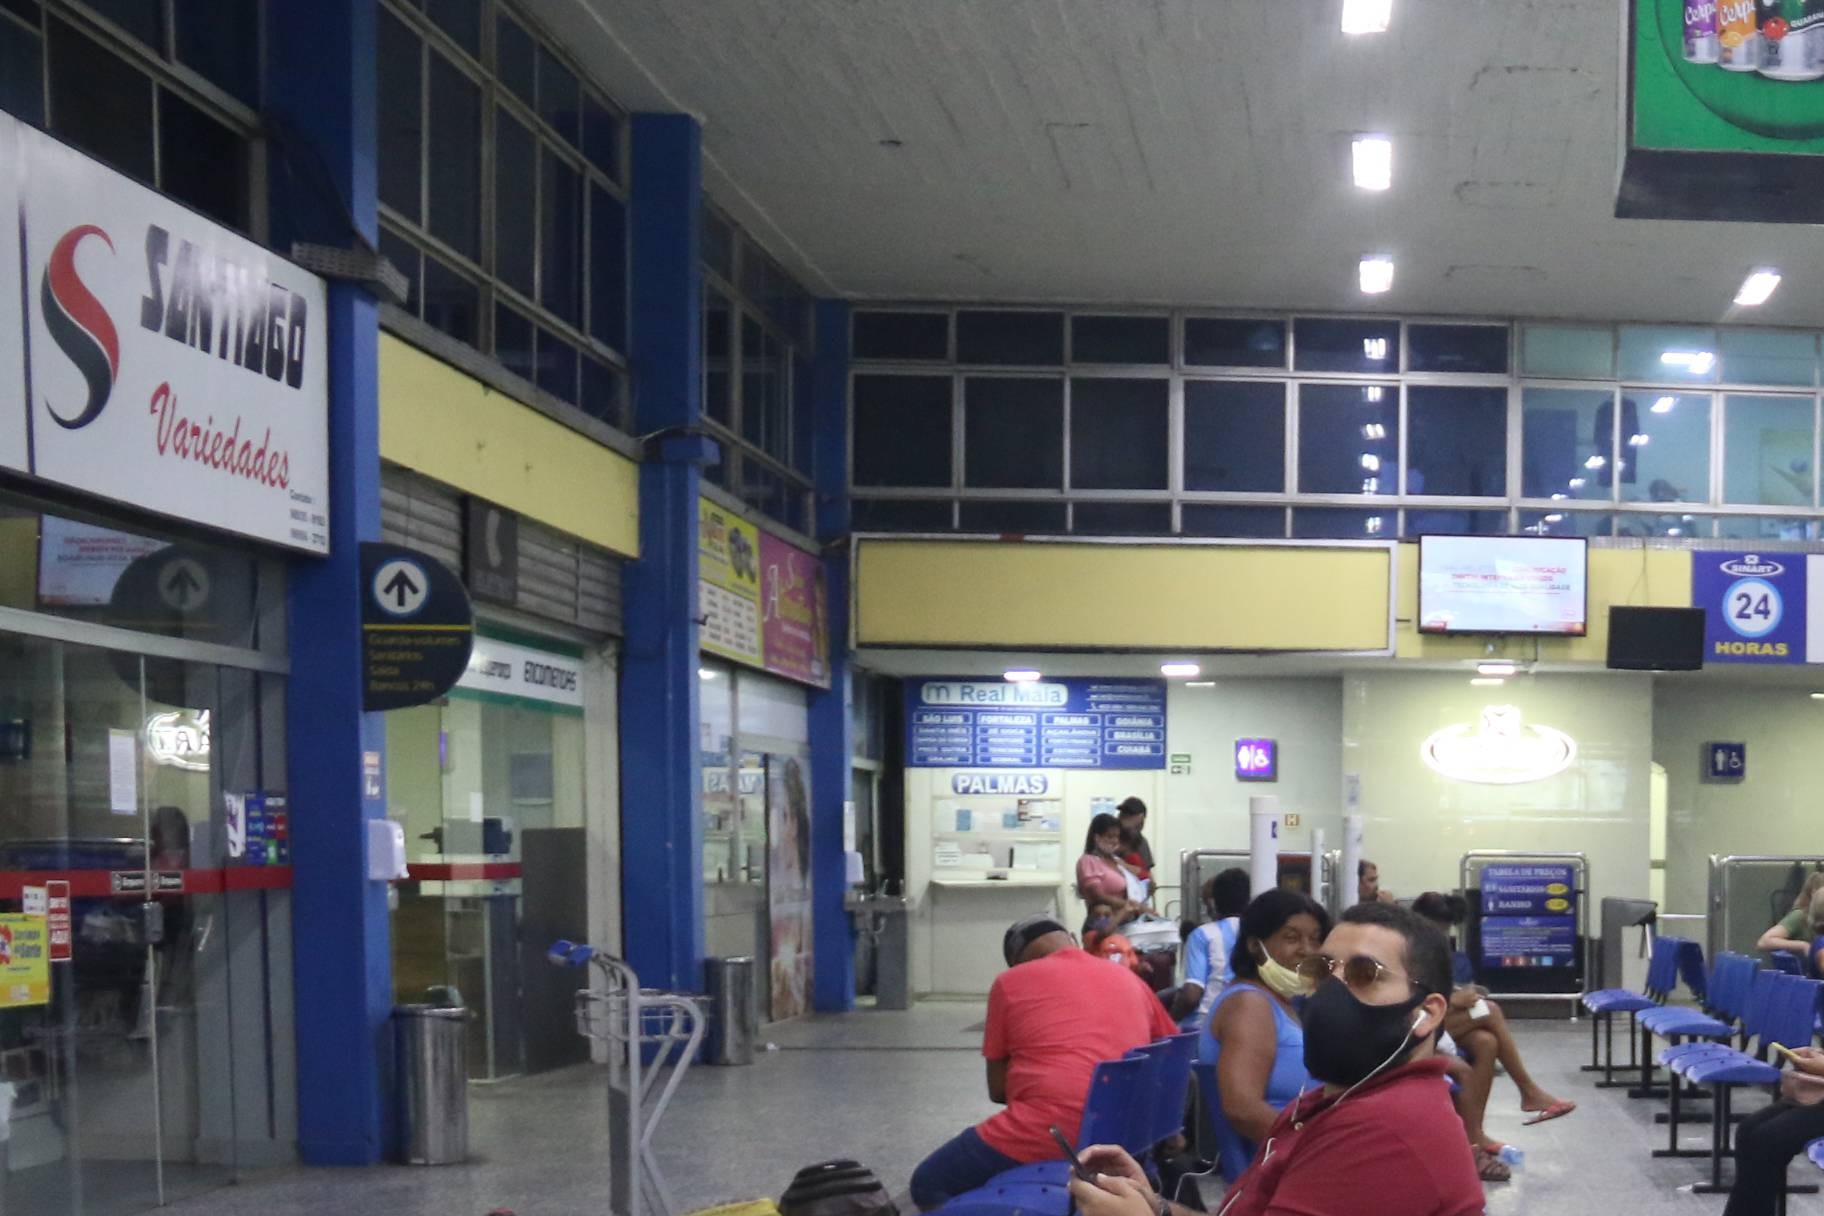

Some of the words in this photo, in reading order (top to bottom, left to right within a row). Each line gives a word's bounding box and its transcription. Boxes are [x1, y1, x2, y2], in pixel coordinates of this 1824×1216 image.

[140, 223, 308, 390] SANTIAGO
[150, 381, 290, 490] Variedades
[1735, 592, 1771, 620] 24
[1715, 641, 1788, 656] HORAS
[523, 660, 577, 692] ENCOMENDAS
[961, 685, 1005, 701] Real
[981, 715, 1032, 725] FORTALEZA
[956, 774, 1045, 793] PALMAS
